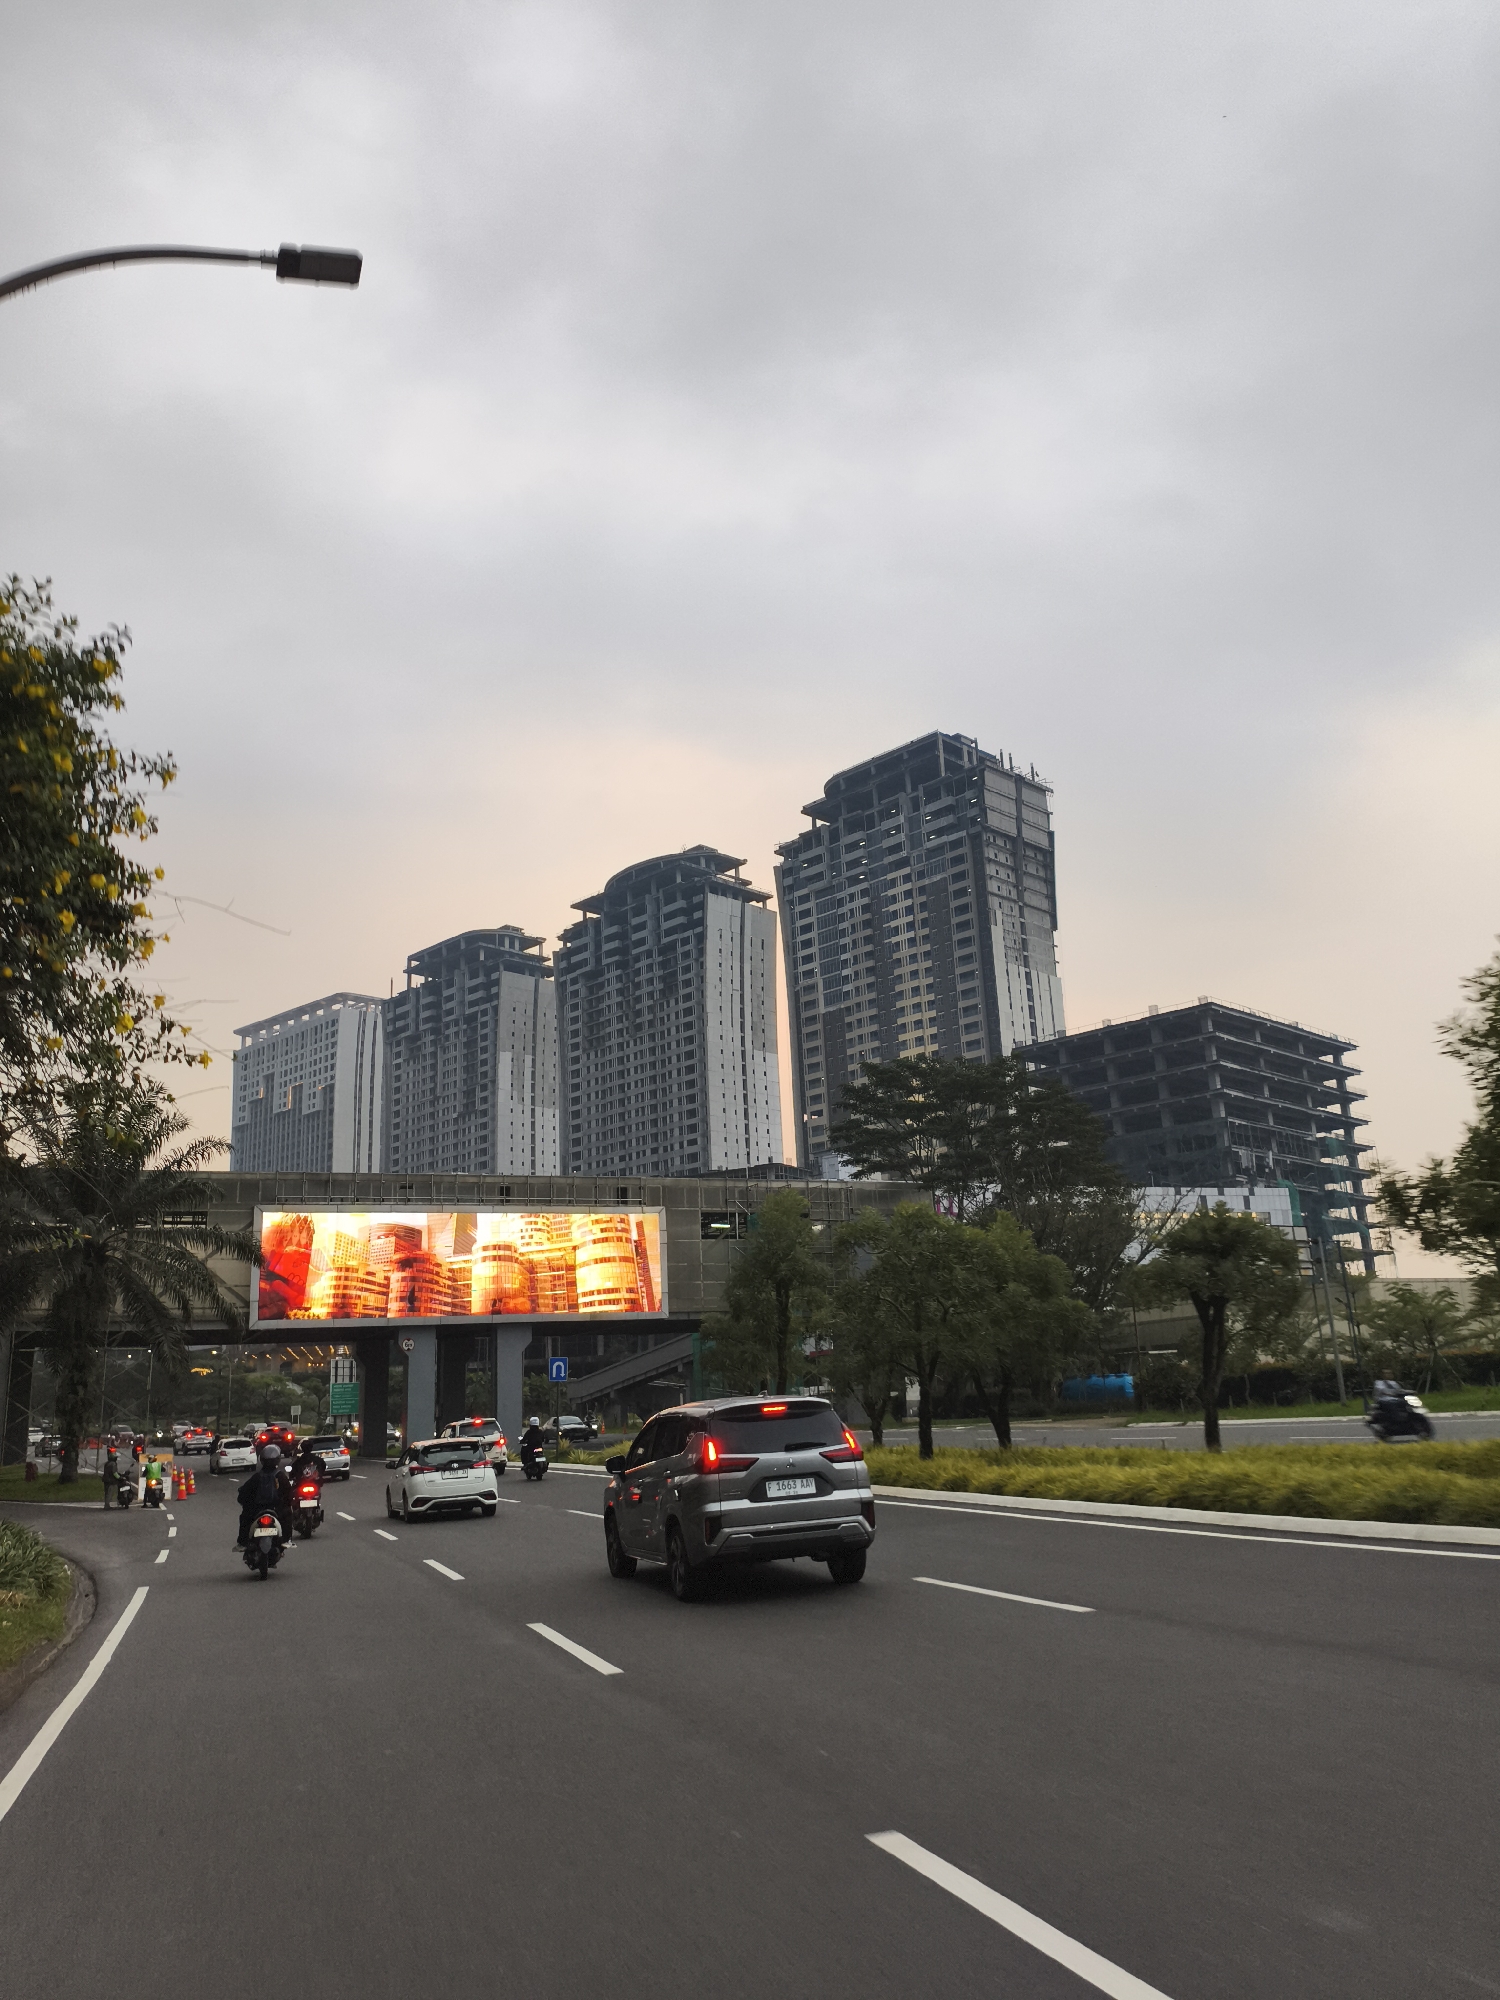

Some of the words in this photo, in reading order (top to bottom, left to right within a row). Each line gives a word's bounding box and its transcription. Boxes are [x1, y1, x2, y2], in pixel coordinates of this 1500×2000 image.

[767, 1483, 772, 1491] F
[776, 1480, 797, 1491] 1663
[800, 1478, 814, 1489] AAY
